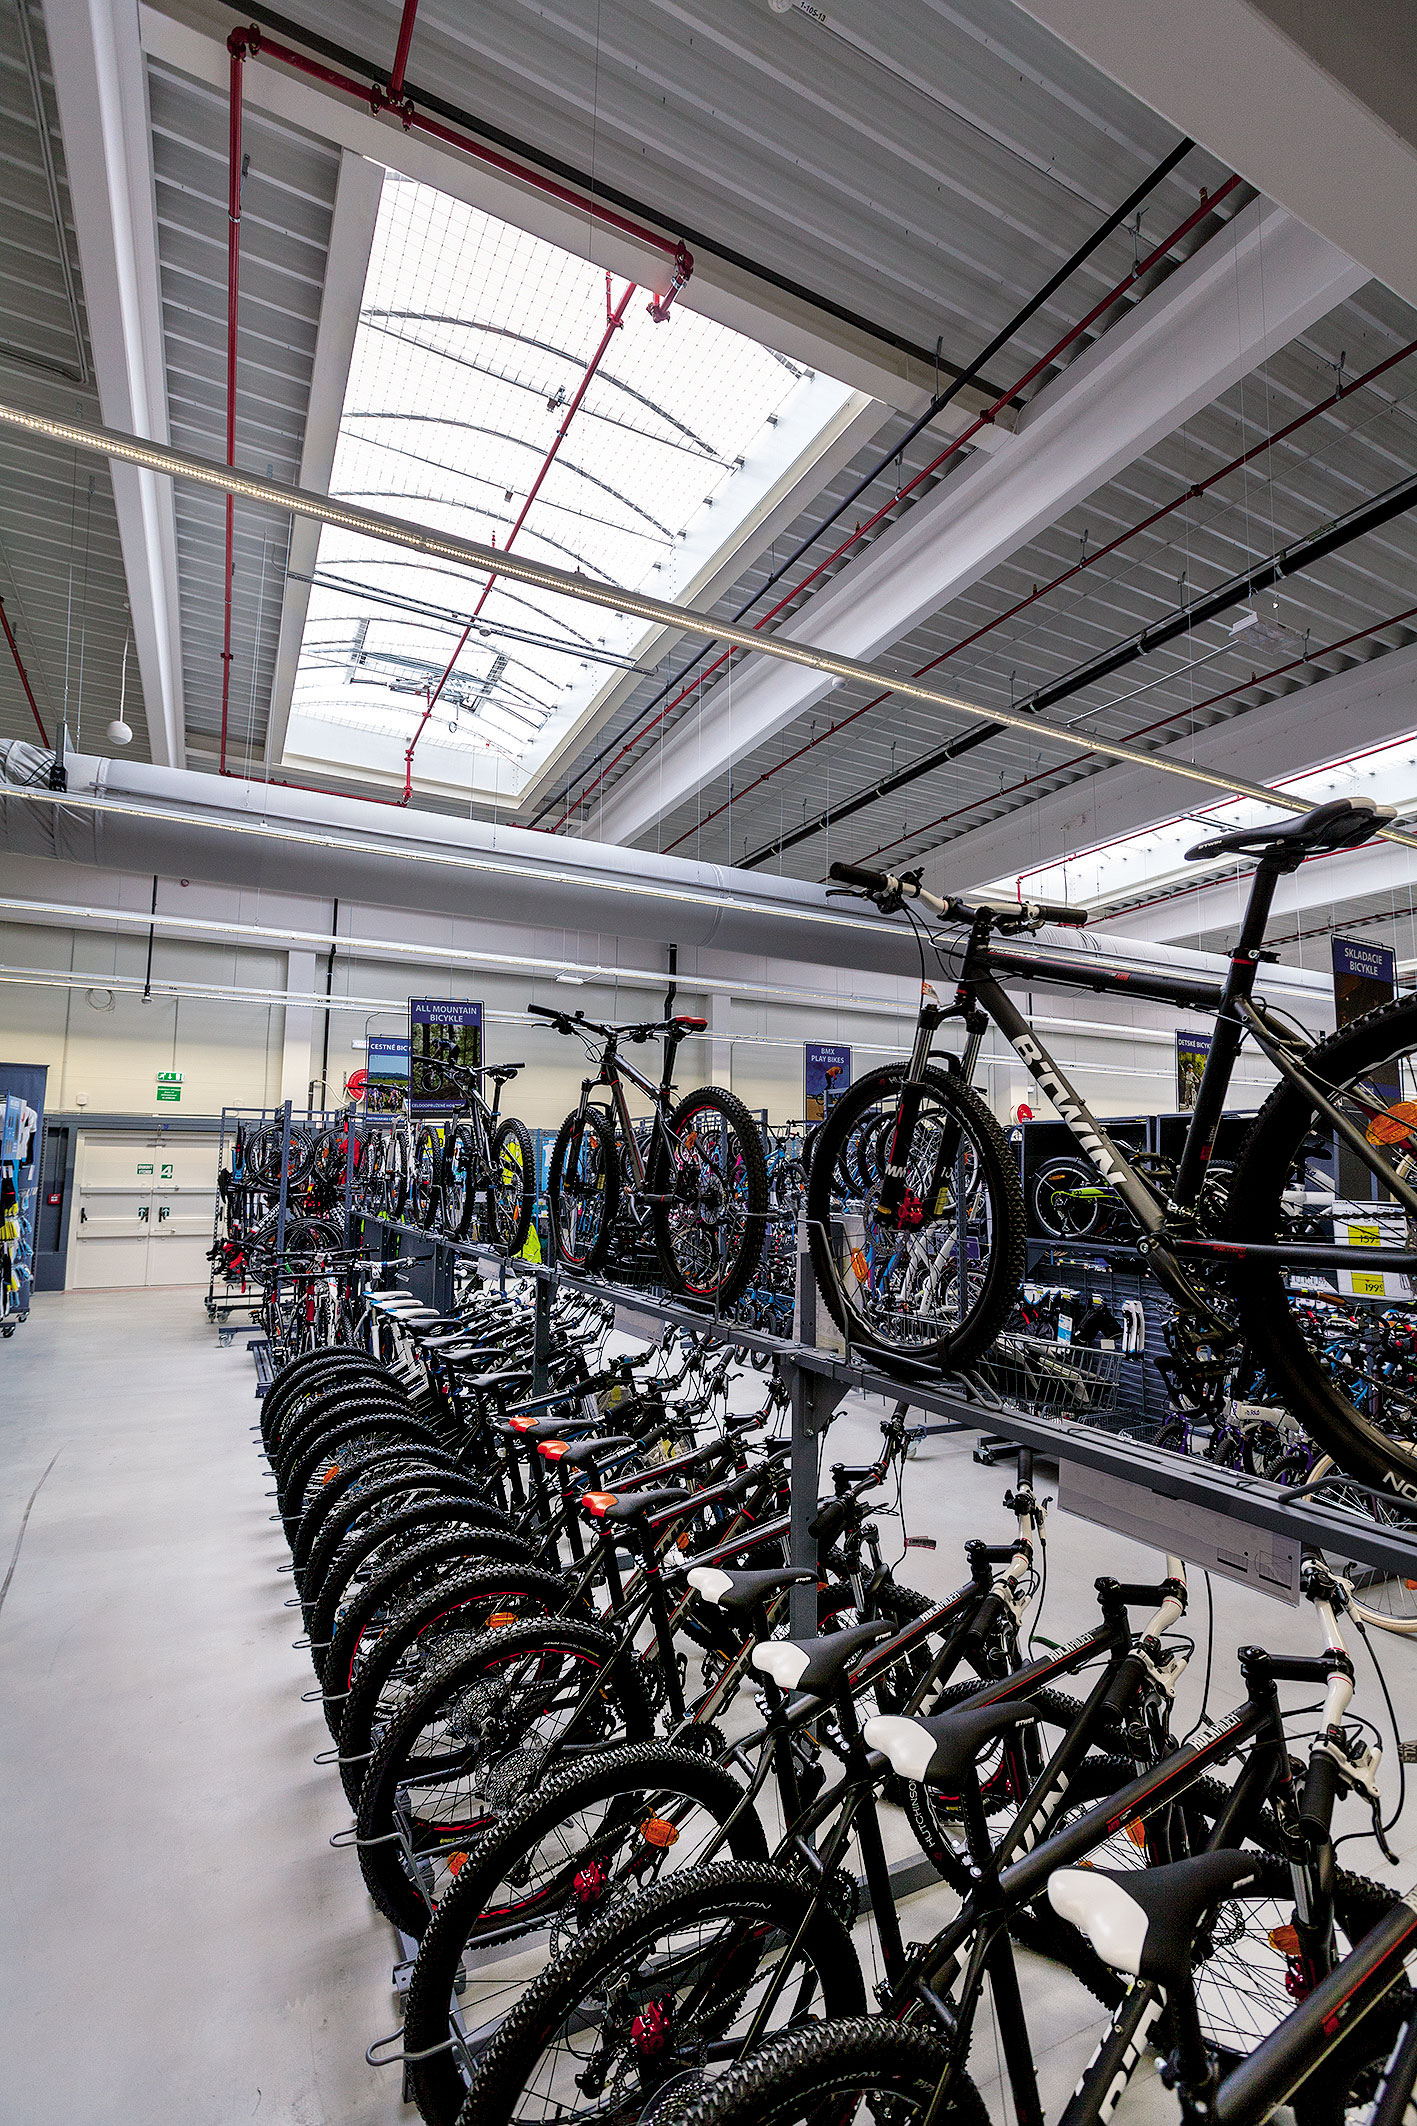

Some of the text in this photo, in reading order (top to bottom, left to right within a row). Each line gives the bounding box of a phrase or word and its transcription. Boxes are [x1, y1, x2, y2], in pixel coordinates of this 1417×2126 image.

[1344, 947, 1383, 965] SKLADACIE
[1349, 961, 1378, 976] BICYKLE
[415, 1004, 477, 1015] ALL MOUNTAIN
[430, 1013, 464, 1023] BICYKLE
[370, 1043, 396, 1051] CESTNÉ
[820, 1047, 836, 1055] BMX
[811, 1054, 845, 1064] PLAY BIKES
